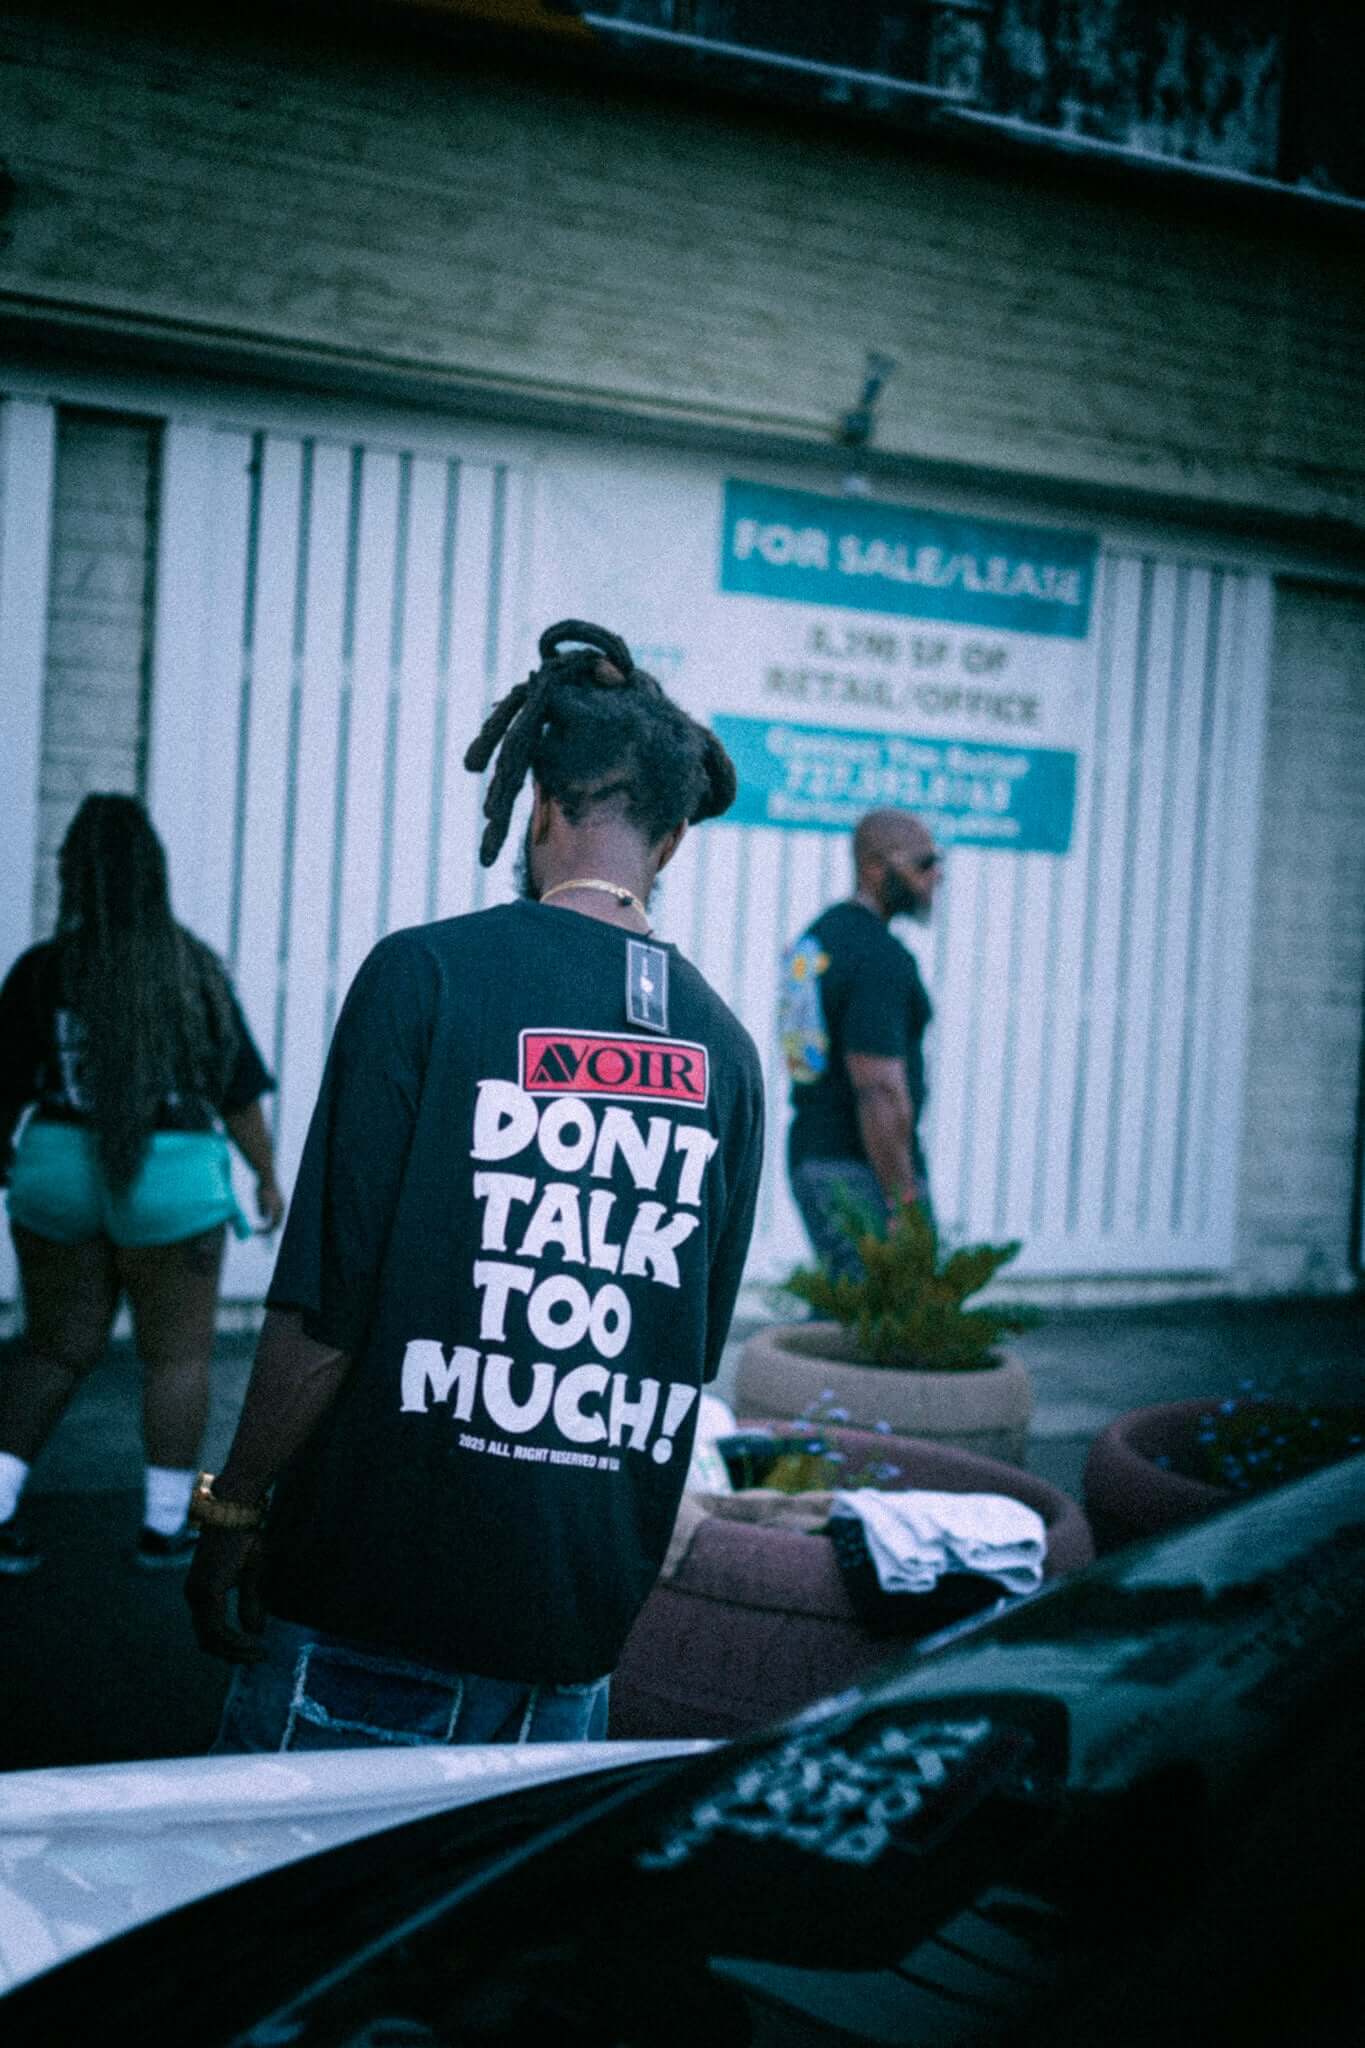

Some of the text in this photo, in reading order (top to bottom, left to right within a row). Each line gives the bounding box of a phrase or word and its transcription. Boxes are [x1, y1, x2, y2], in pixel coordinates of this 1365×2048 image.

[734, 519, 829, 569] FOR
[531, 1043, 702, 1093] AVOIR
[473, 1171, 700, 1288] TALK
[473, 1259, 632, 1358] TOO
[400, 1338, 698, 1464] MUCH!
[487, 1440, 511, 1457] ALL
[550, 1449, 597, 1468] RESERVED
